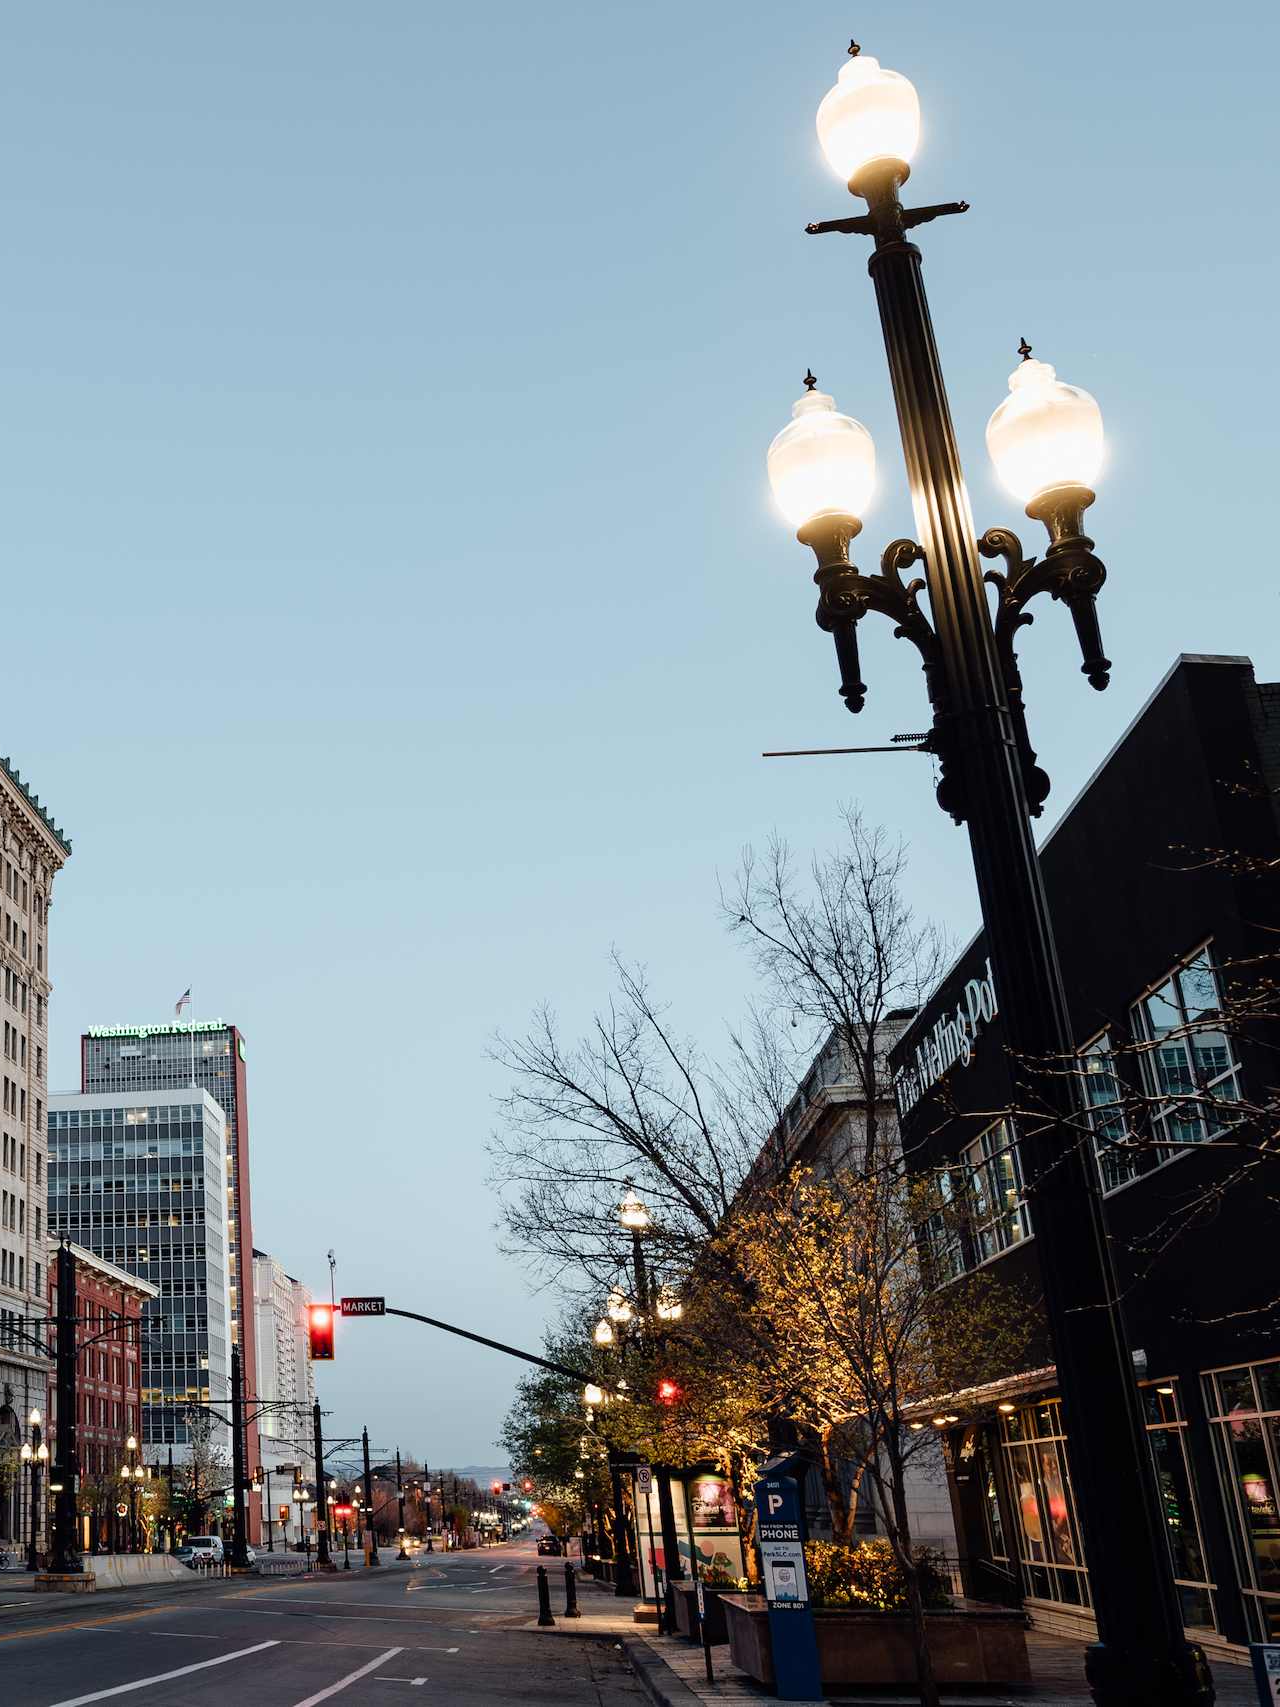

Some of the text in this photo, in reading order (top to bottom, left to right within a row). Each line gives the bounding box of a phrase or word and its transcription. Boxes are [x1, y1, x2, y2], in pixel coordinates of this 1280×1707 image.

[88, 1022, 170, 1039] Washington
[915, 1002, 971, 1096] Melting
[964, 956, 999, 1039] Pot
[343, 1301, 383, 1312] MARKET
[767, 1494, 784, 1515] P
[761, 1529, 800, 1540] PHONE
[792, 1602, 805, 1610] 801
